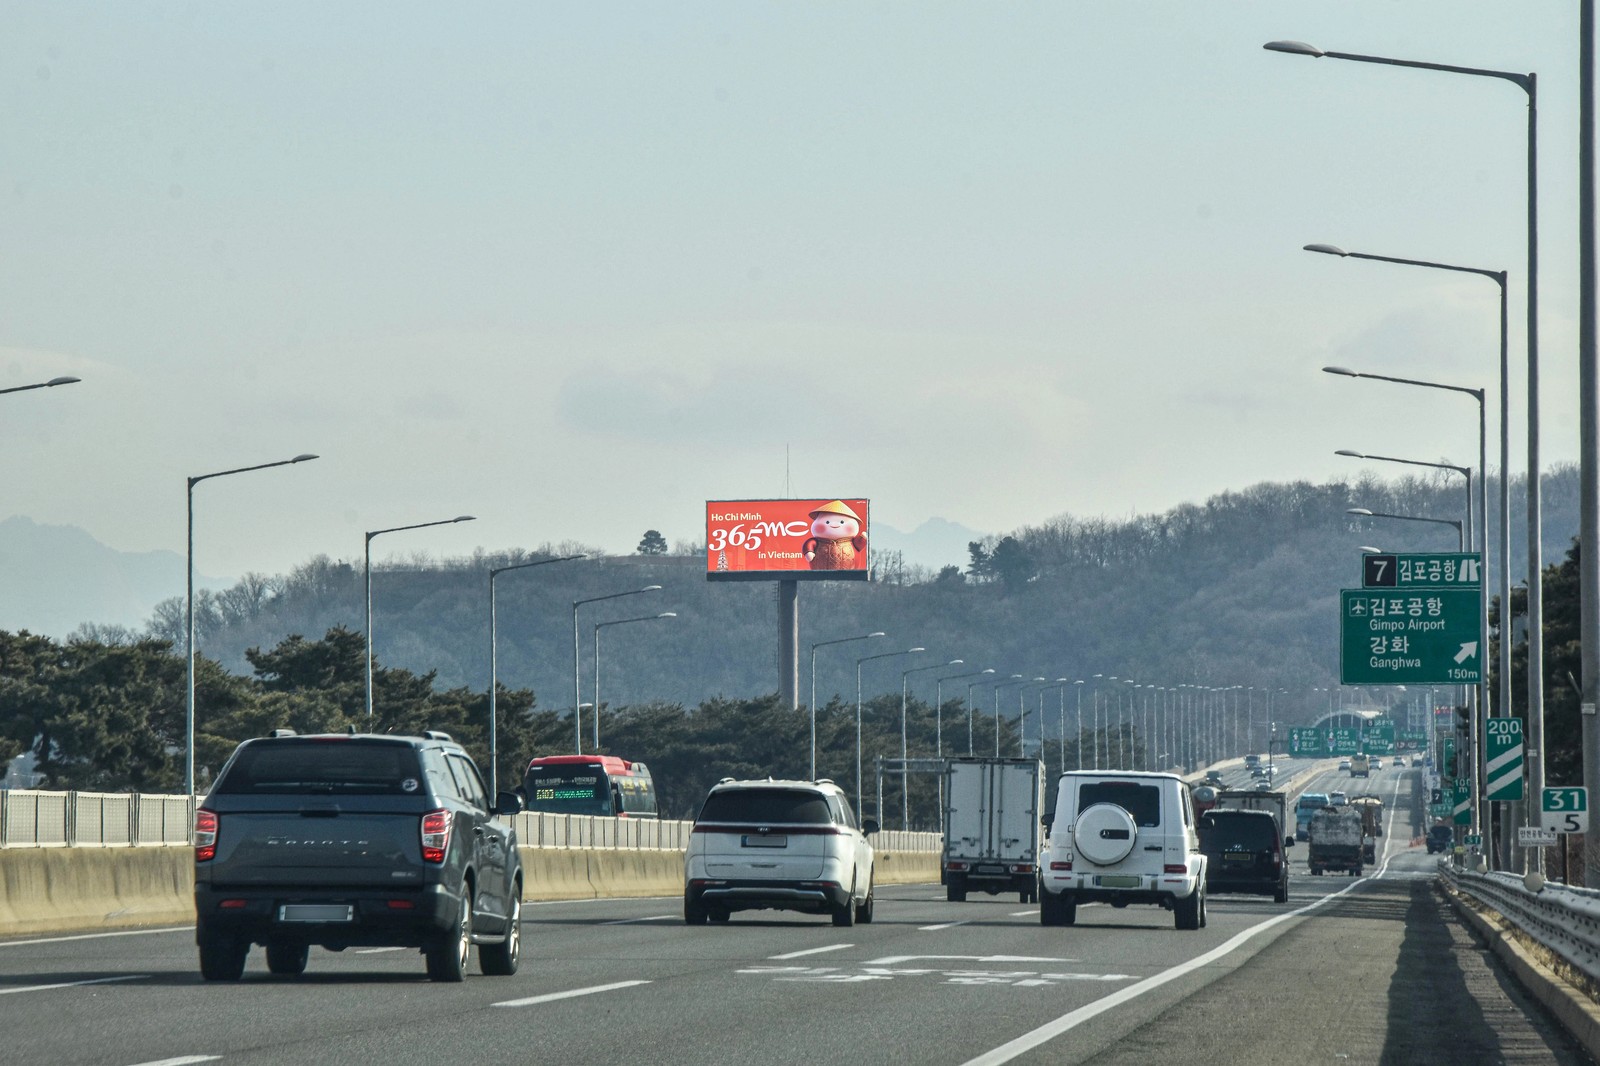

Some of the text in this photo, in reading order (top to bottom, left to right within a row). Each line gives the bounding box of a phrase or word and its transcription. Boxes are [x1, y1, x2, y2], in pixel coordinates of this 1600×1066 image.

[711, 512, 762, 521] Ho Chi Minh
[758, 551, 803, 559] in Vietnam
[1373, 561, 1388, 582] 7
[1400, 559, 1456, 582] 김포공항
[1370, 597, 1443, 617] 김포공항
[1369, 619, 1445, 632] Gimpo Airport
[1370, 635, 1410, 654] 강화
[1369, 656, 1421, 670] Ganghwa
[1447, 669, 1478, 679] 150m
[1488, 720, 1520, 734] 200
[1496, 734, 1512, 745] m
[1549, 790, 1580, 810] 31
